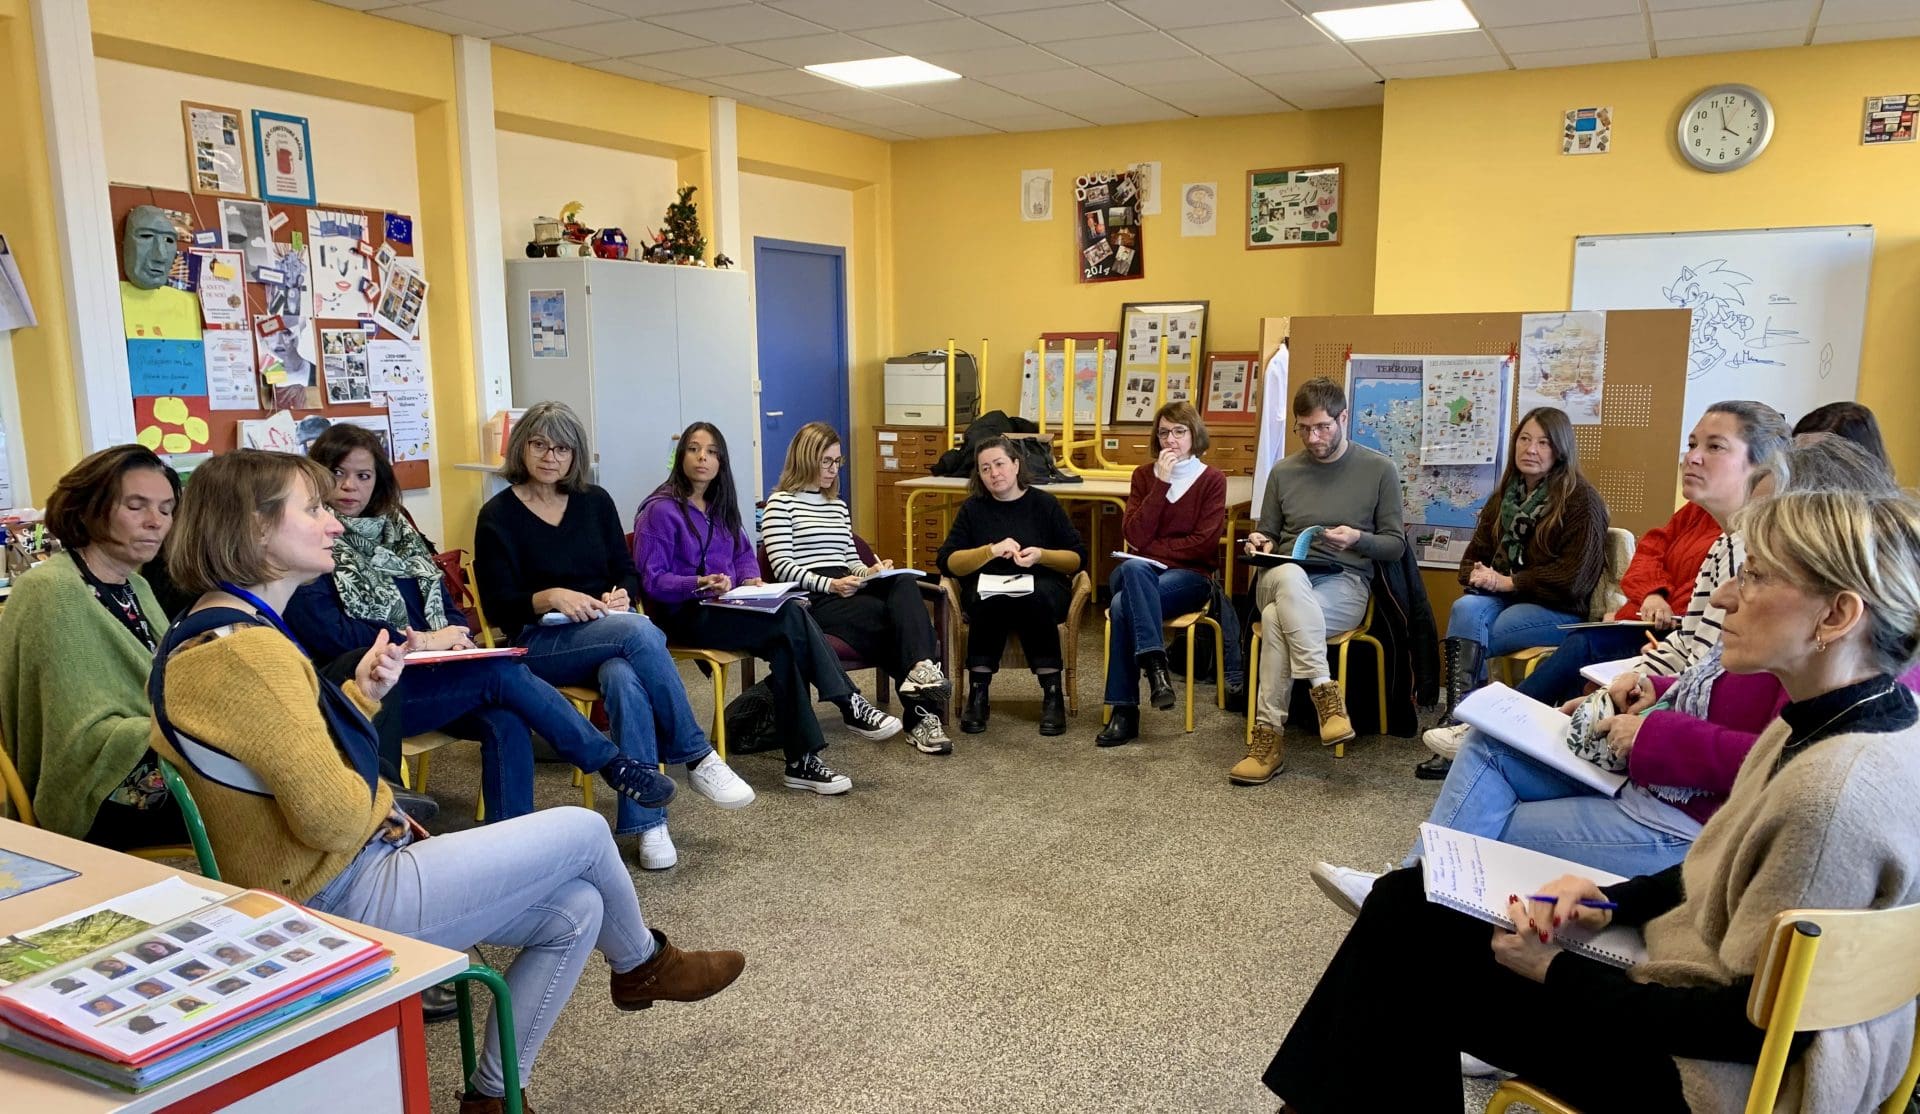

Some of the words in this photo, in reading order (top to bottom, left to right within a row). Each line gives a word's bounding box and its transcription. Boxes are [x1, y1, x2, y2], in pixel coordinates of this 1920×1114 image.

[1725, 96, 1735, 104] 12
[1743, 99, 1747, 107] 1
[1711, 101, 1718, 109] 11
[1697, 111, 1708, 120] 10
[1751, 109, 1757, 118] 2
[1693, 125, 1699, 133] 9
[1753, 123, 1759, 131] 3
[1695, 139, 1701, 147] 8
[1747, 137, 1753, 145] 4
[1706, 149, 1711, 157] 7
[1719, 152, 1725, 160] 6
[1735, 148, 1740, 156] 5
[1186, 185, 1214, 224] S
[1085, 265, 1110, 278] 2014
